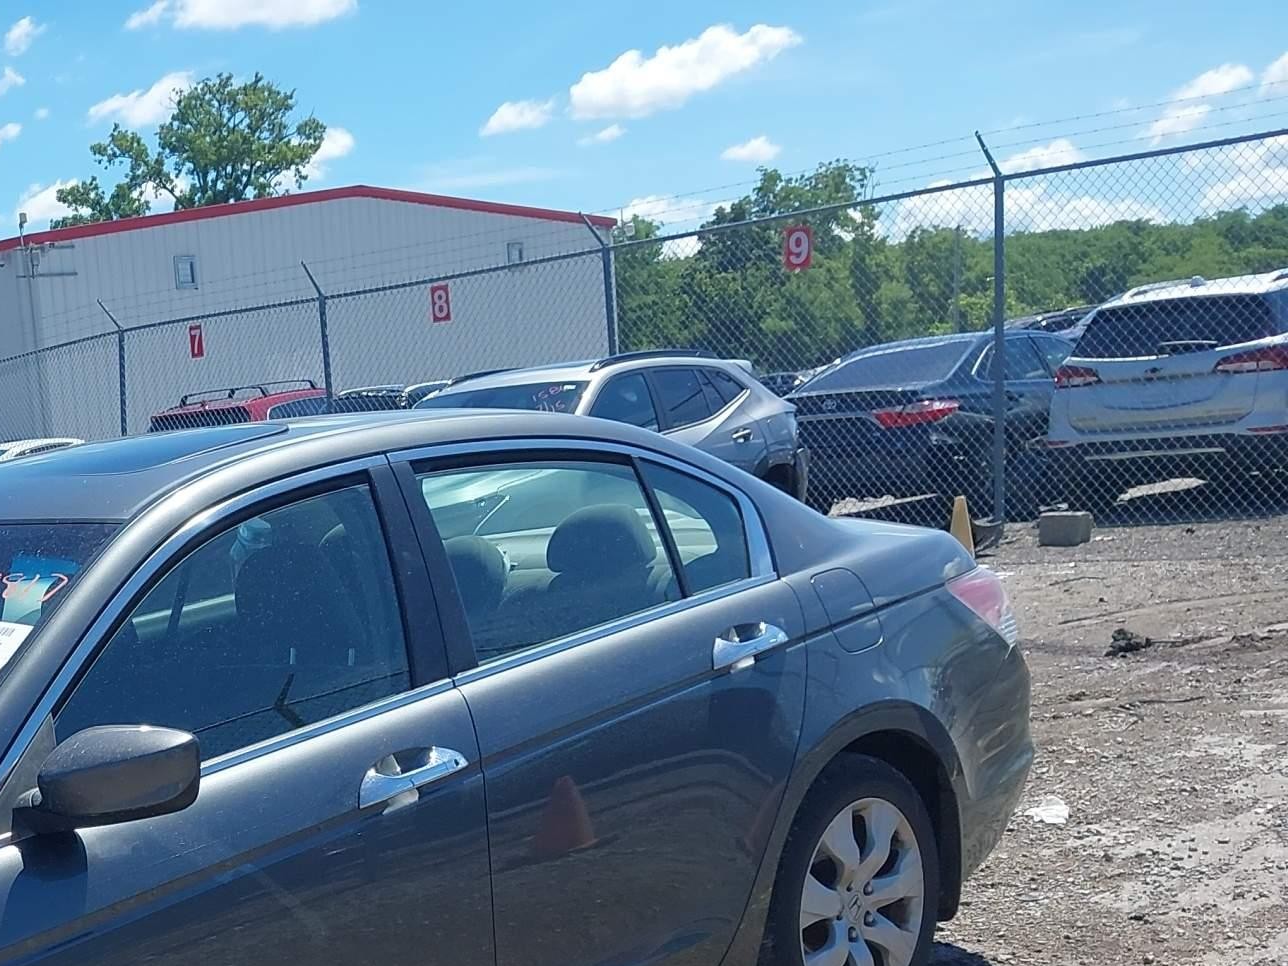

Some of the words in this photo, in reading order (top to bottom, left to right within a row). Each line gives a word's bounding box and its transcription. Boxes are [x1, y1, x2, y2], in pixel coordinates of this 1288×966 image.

[789, 231, 809, 265] 9
[433, 289, 449, 318] 8
[190, 328, 202, 354] 7
